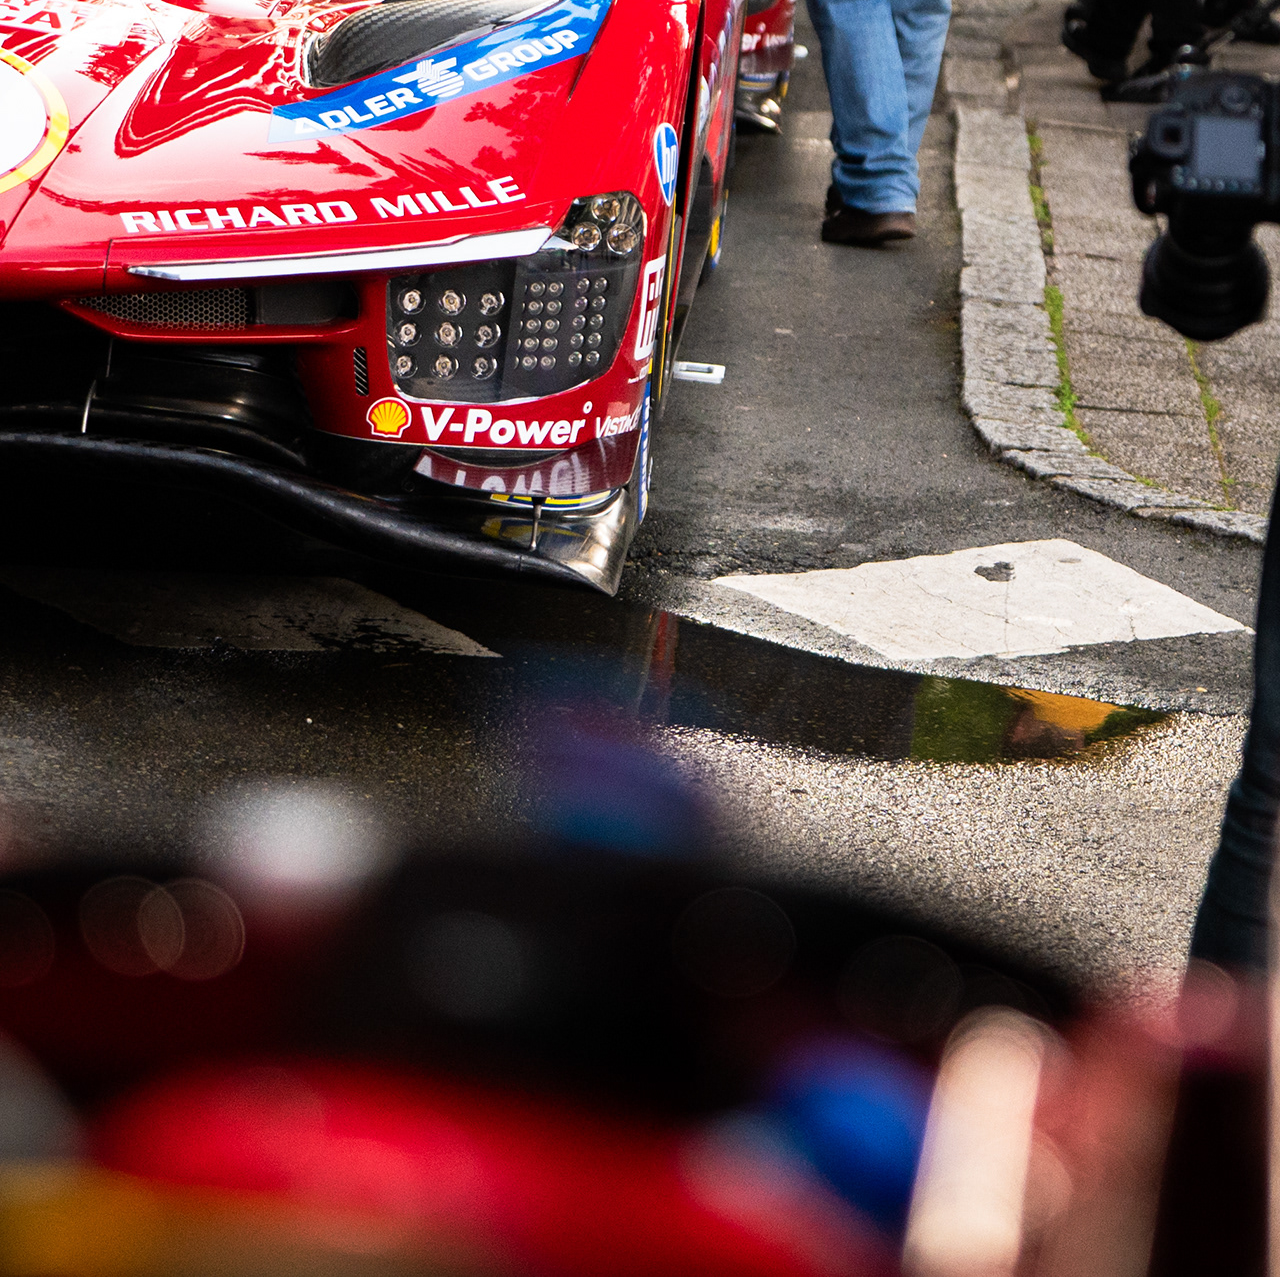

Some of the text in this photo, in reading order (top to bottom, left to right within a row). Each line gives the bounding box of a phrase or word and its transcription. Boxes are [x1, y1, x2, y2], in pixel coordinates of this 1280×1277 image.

[463, 29, 580, 82] GROUP
[293, 87, 424, 135] ADLER
[120, 176, 526, 234] RICHARD MILLE
[420, 406, 586, 445] V-Power
